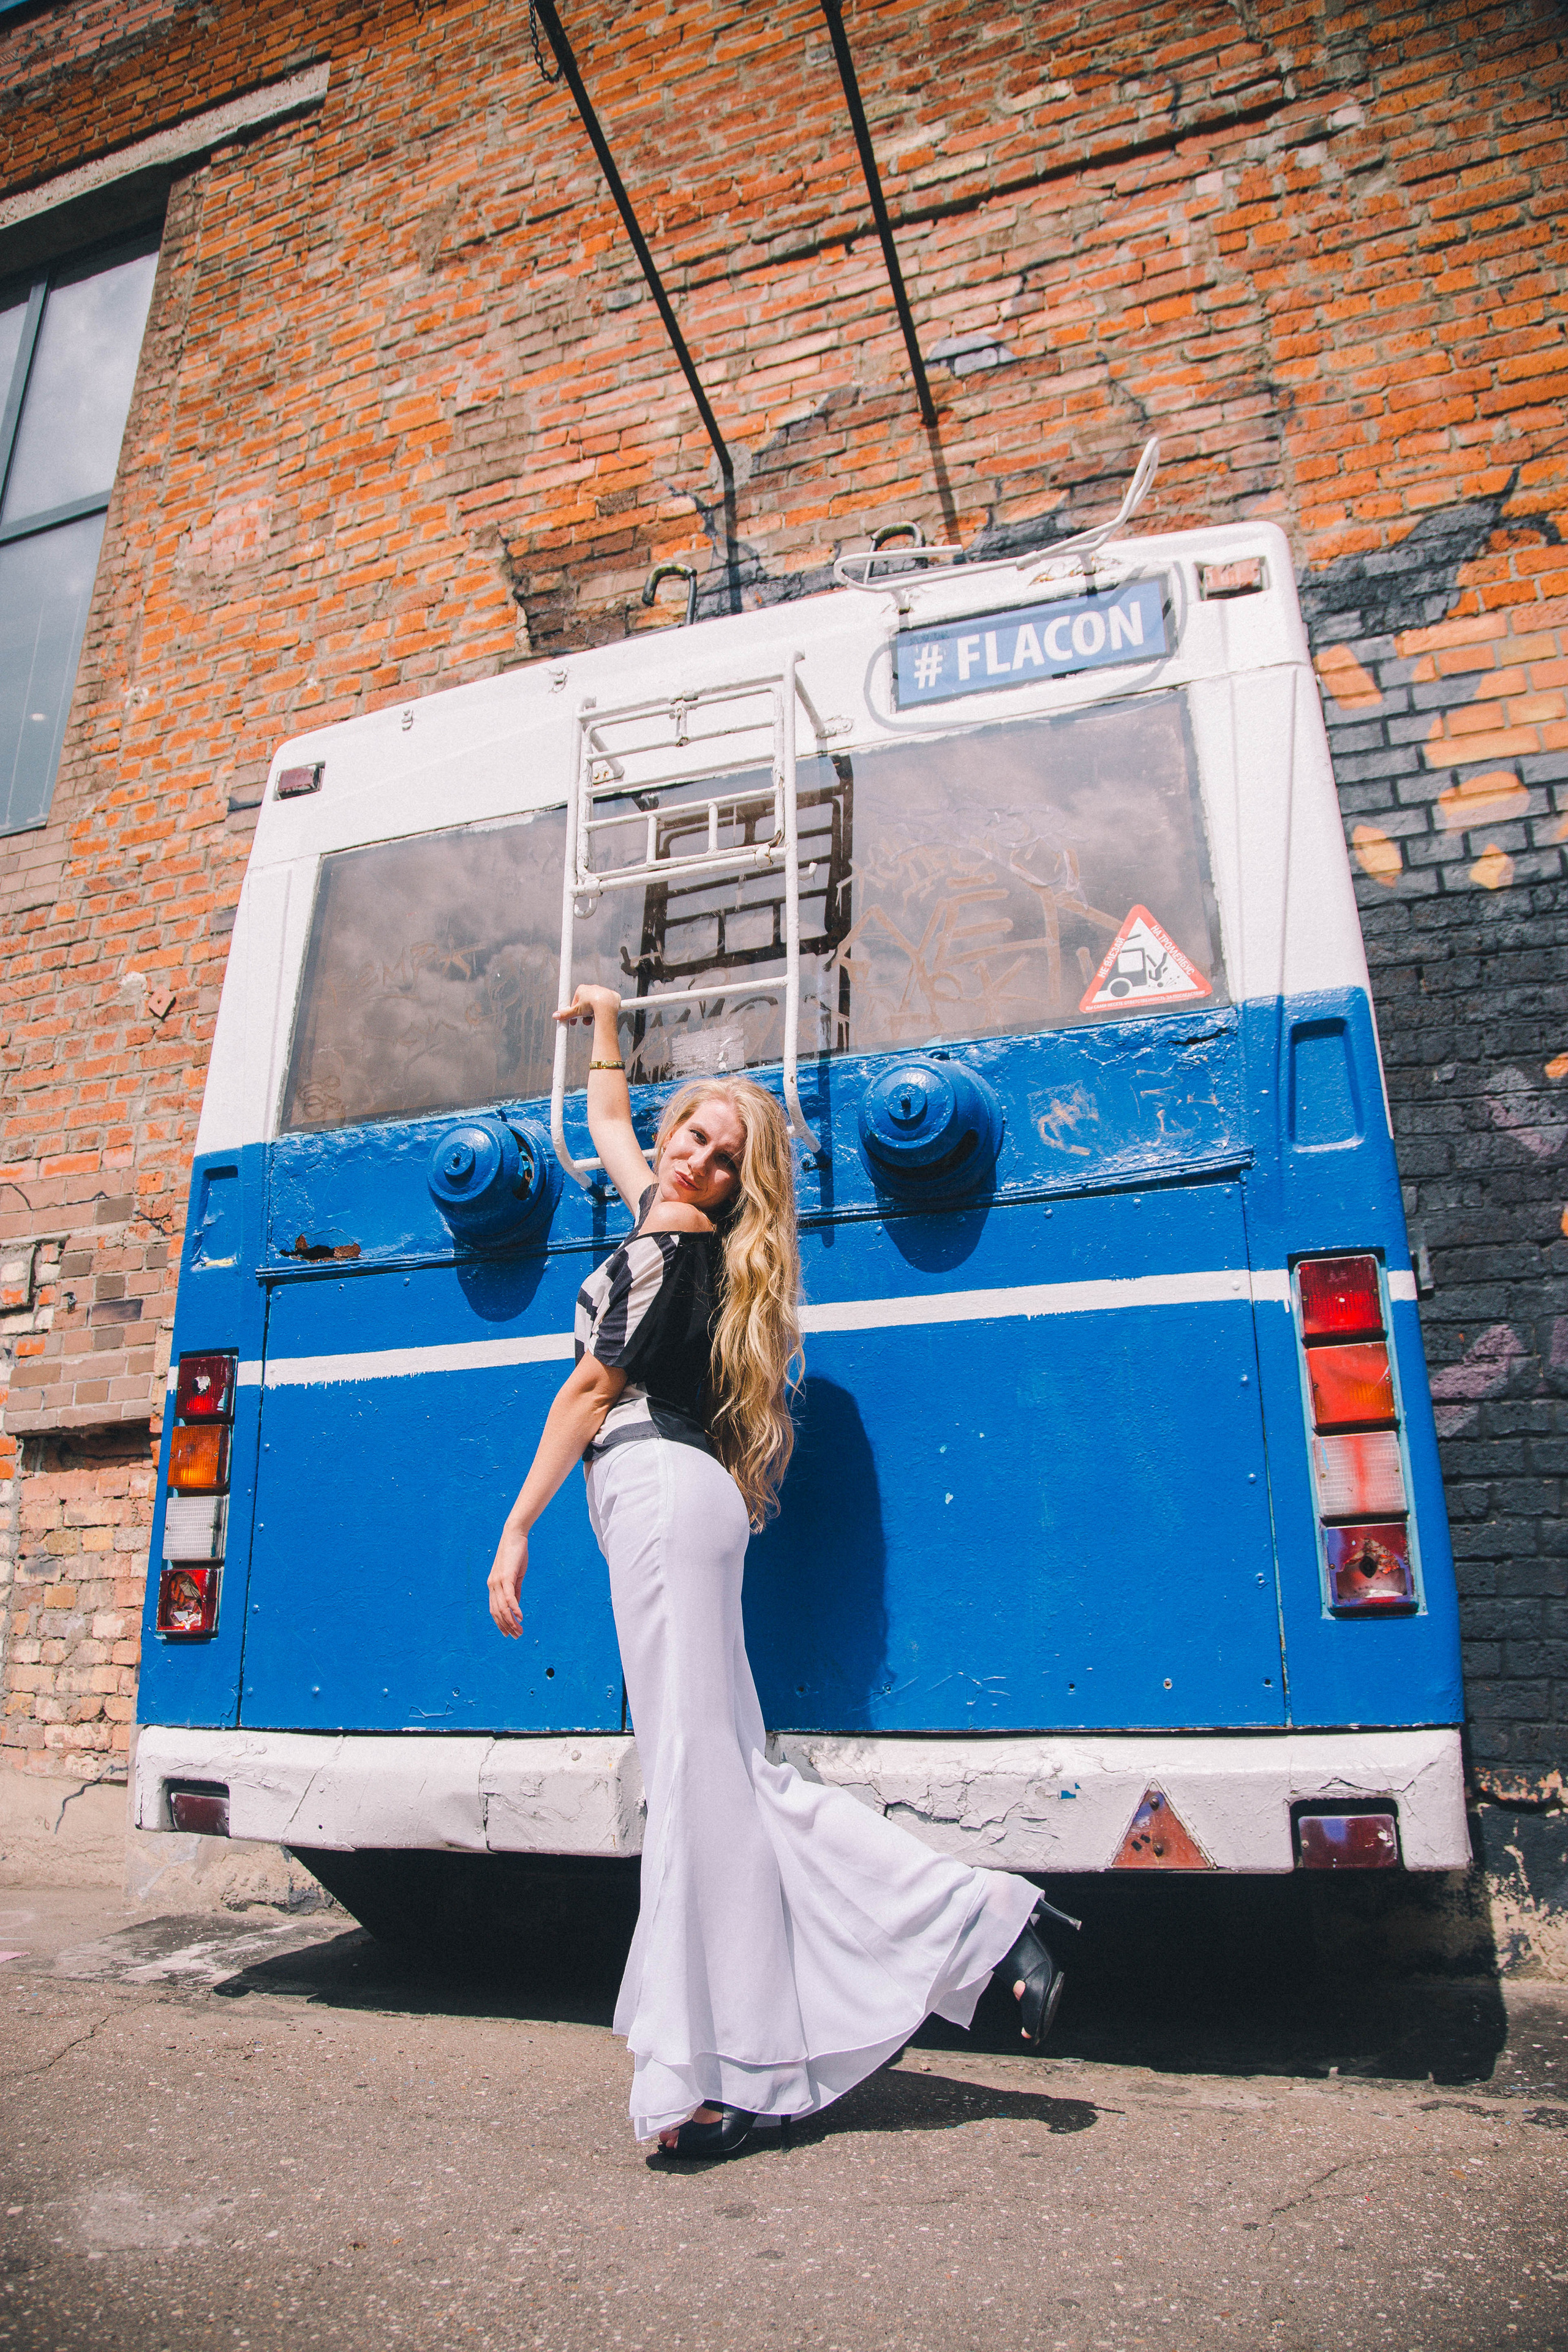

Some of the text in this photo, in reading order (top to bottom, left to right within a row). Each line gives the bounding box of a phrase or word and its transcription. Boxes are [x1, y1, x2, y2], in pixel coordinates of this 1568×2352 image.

[957, 601, 1145, 681] FLACON
[1098, 937, 1126, 978] НЕ ВЛЕЗАЙ
[1150, 925, 1195, 975] НА ТРОЛЛЕЙБУС
